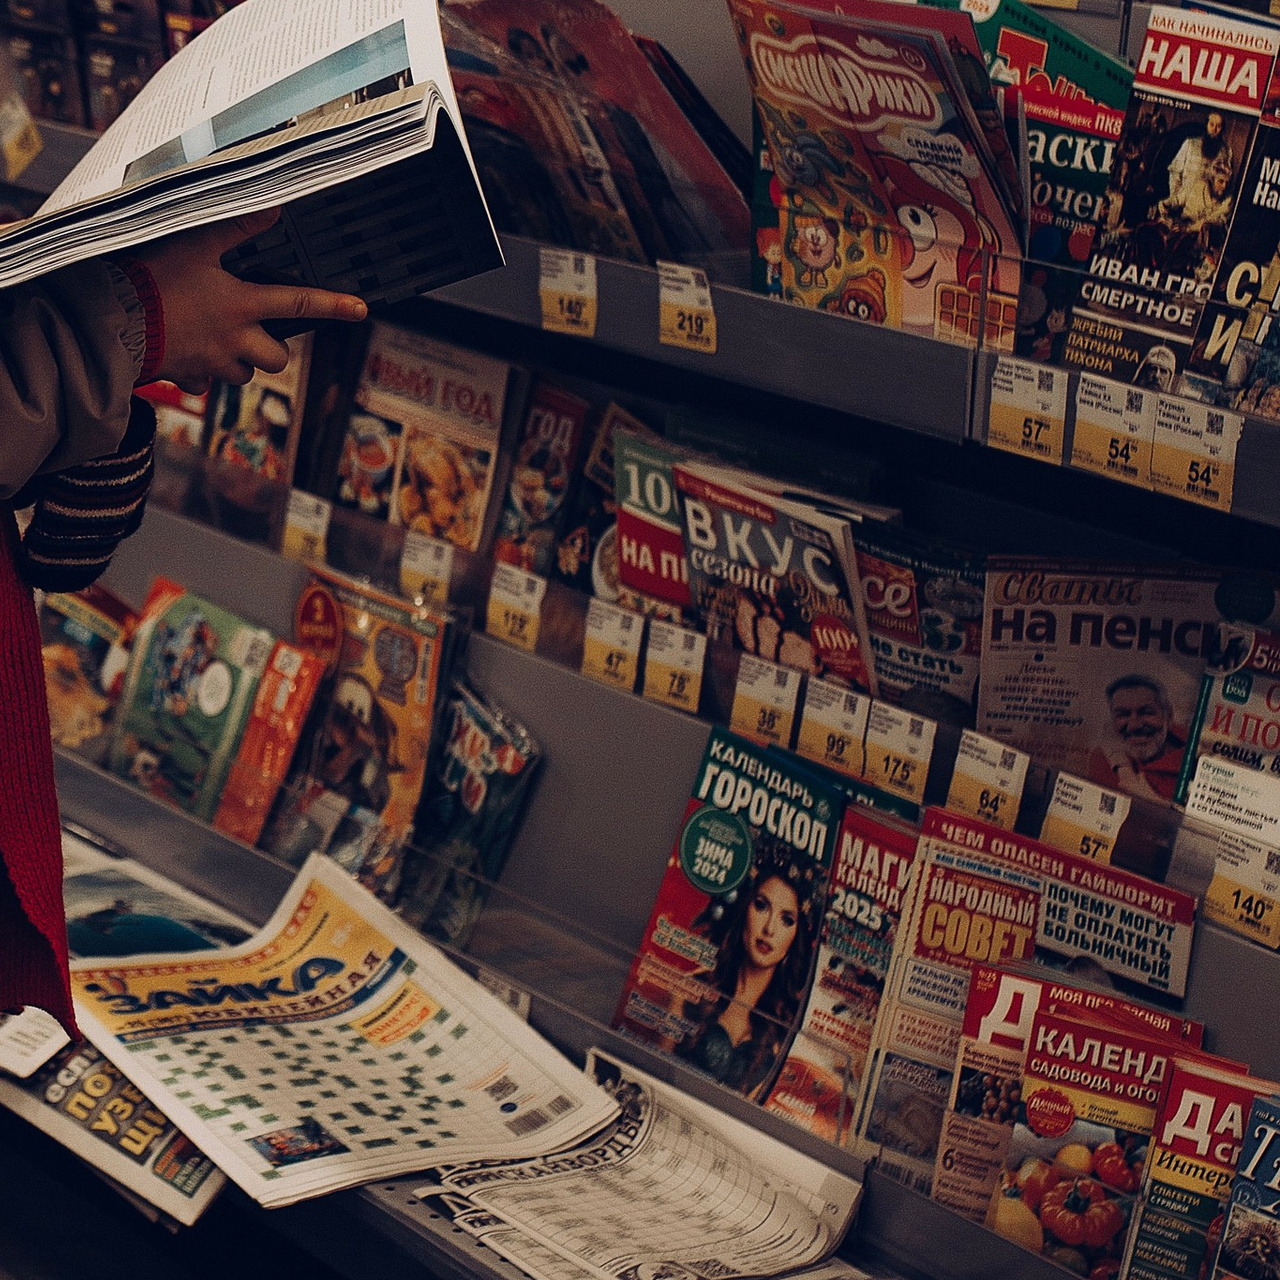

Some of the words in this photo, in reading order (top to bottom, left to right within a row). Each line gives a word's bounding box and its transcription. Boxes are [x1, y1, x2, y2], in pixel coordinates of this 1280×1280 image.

[1151, 14, 1177, 32] КАК
[1178, 19, 1273, 52] НАЧИНАЛИСЬ
[756, 43, 932, 117] СМЕШАРИКИ
[1138, 35, 1259, 100] НАША
[1089, 254, 1161, 284] ИВАН
[1081, 279, 1197, 329] СМЕРТНОЕ
[1067, 332, 1140, 364] ПАТРИАРХА
[1070, 317, 1125, 343] ЖРЕБИЙ
[1065, 348, 1114, 372] ТИХОНА
[1023, 416, 1044, 443] 57
[1108, 437, 1132, 465] 54
[1188, 460, 1213, 488] 54
[621, 534, 656, 575] НА
[683, 496, 840, 597] ВКУС
[690, 547, 776, 597] сезона
[898, 643, 963, 675] стать
[709, 737, 815, 810] КАЛЕНДАРЬ
[1211, 739, 1266, 772] солим,
[697, 762, 829, 861] ГОРОСКОП
[979, 789, 1000, 813] 64
[694, 836, 735, 872] ЗИМА
[1079, 836, 1103, 860] 57
[691, 856, 728, 886] 2024
[940, 820, 985, 850] ЧЕМ
[990, 837, 1066, 880] ОПАСЕН
[1070, 863, 1177, 918] ГАЙМОРИТ
[830, 885, 883, 933] 2025
[930, 875, 1037, 928] НАРОДНЫЙ
[1047, 882, 1116, 920] ПОЧЕМУ
[1119, 906, 1177, 942] МОГУТ
[1231, 888, 1265, 921] 140
[921, 901, 1034, 965] СОВЕТ
[1042, 919, 1172, 981] БОЛЬНИЧНЫЙ
[1046, 902, 1069, 926] НЕ
[1073, 911, 1172, 961] ОПЛАТИТЬ
[102, 957, 346, 1015] ЗАЙКА
[191, 950, 382, 1022] ЮБИЛЕЙНАЯ
[1049, 985, 1084, 1005] МОЯ
[1030, 1057, 1111, 1092] САДОВОДА
[1126, 1081, 1161, 1105] ОГО
[1135, 1249, 1188, 1274] МАСКАРАД
